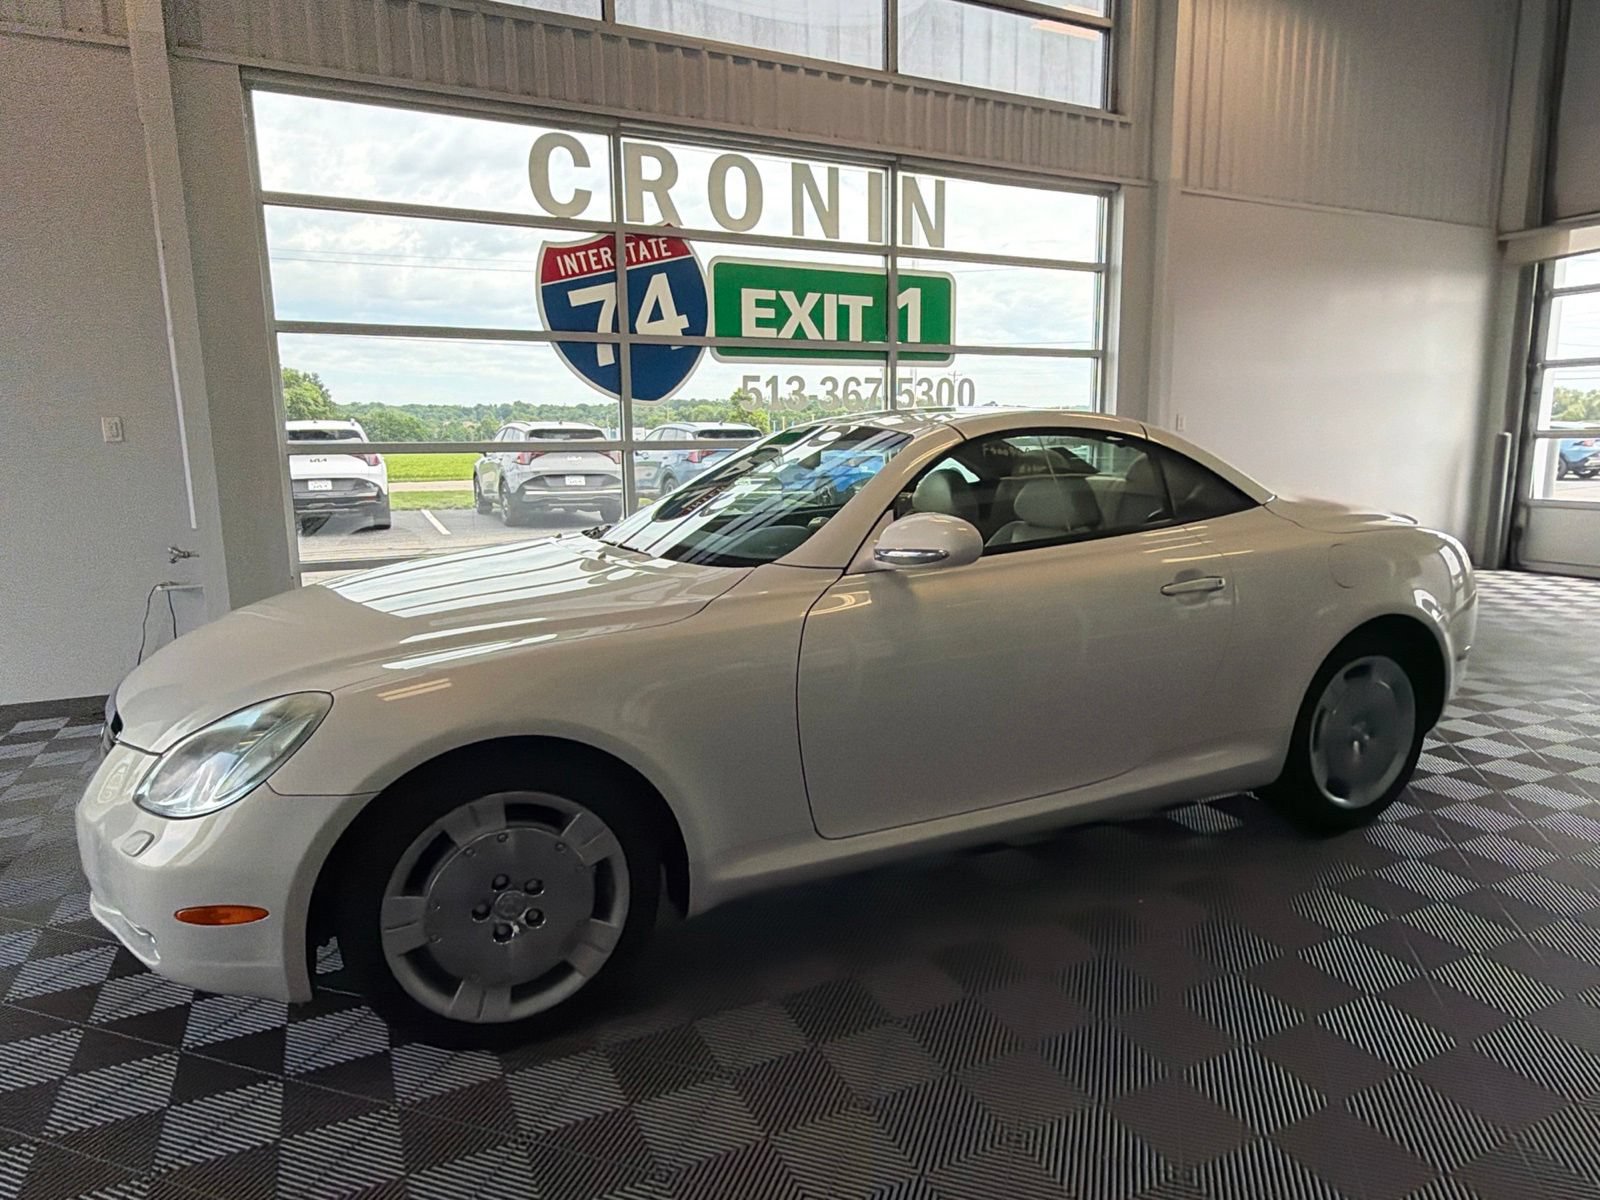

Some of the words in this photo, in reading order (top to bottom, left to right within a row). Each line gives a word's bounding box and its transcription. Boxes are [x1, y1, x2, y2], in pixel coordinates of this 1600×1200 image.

[528, 132, 946, 249] CRONIN
[556, 237, 672, 277] INTERTATE
[568, 272, 690, 367] 74
[741, 287, 874, 342] EXIT
[896, 286, 922, 343] 1
[741, 374, 976, 412] 513-3675300
